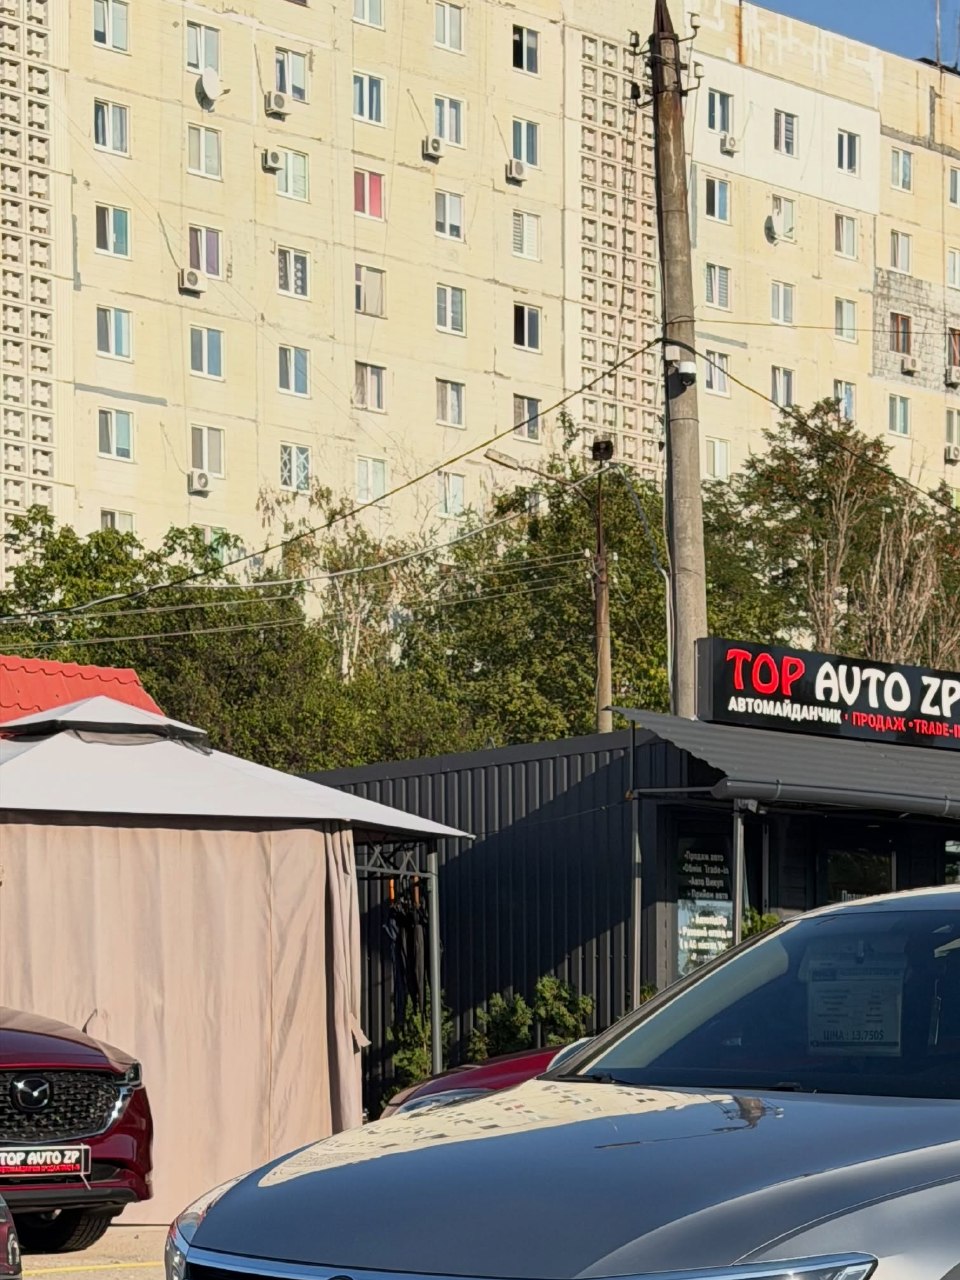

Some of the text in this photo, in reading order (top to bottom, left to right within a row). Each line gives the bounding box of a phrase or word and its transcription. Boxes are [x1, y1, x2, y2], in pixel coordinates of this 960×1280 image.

[727, 648, 805, 696] TOP
[727, 696, 842, 724] АВТОМАЙДАНЧИК
[852, 711, 906, 732] ПРОДАЖ
[0, 1152, 26, 1166] TOP
[63, 1150, 80, 1164] ZP
